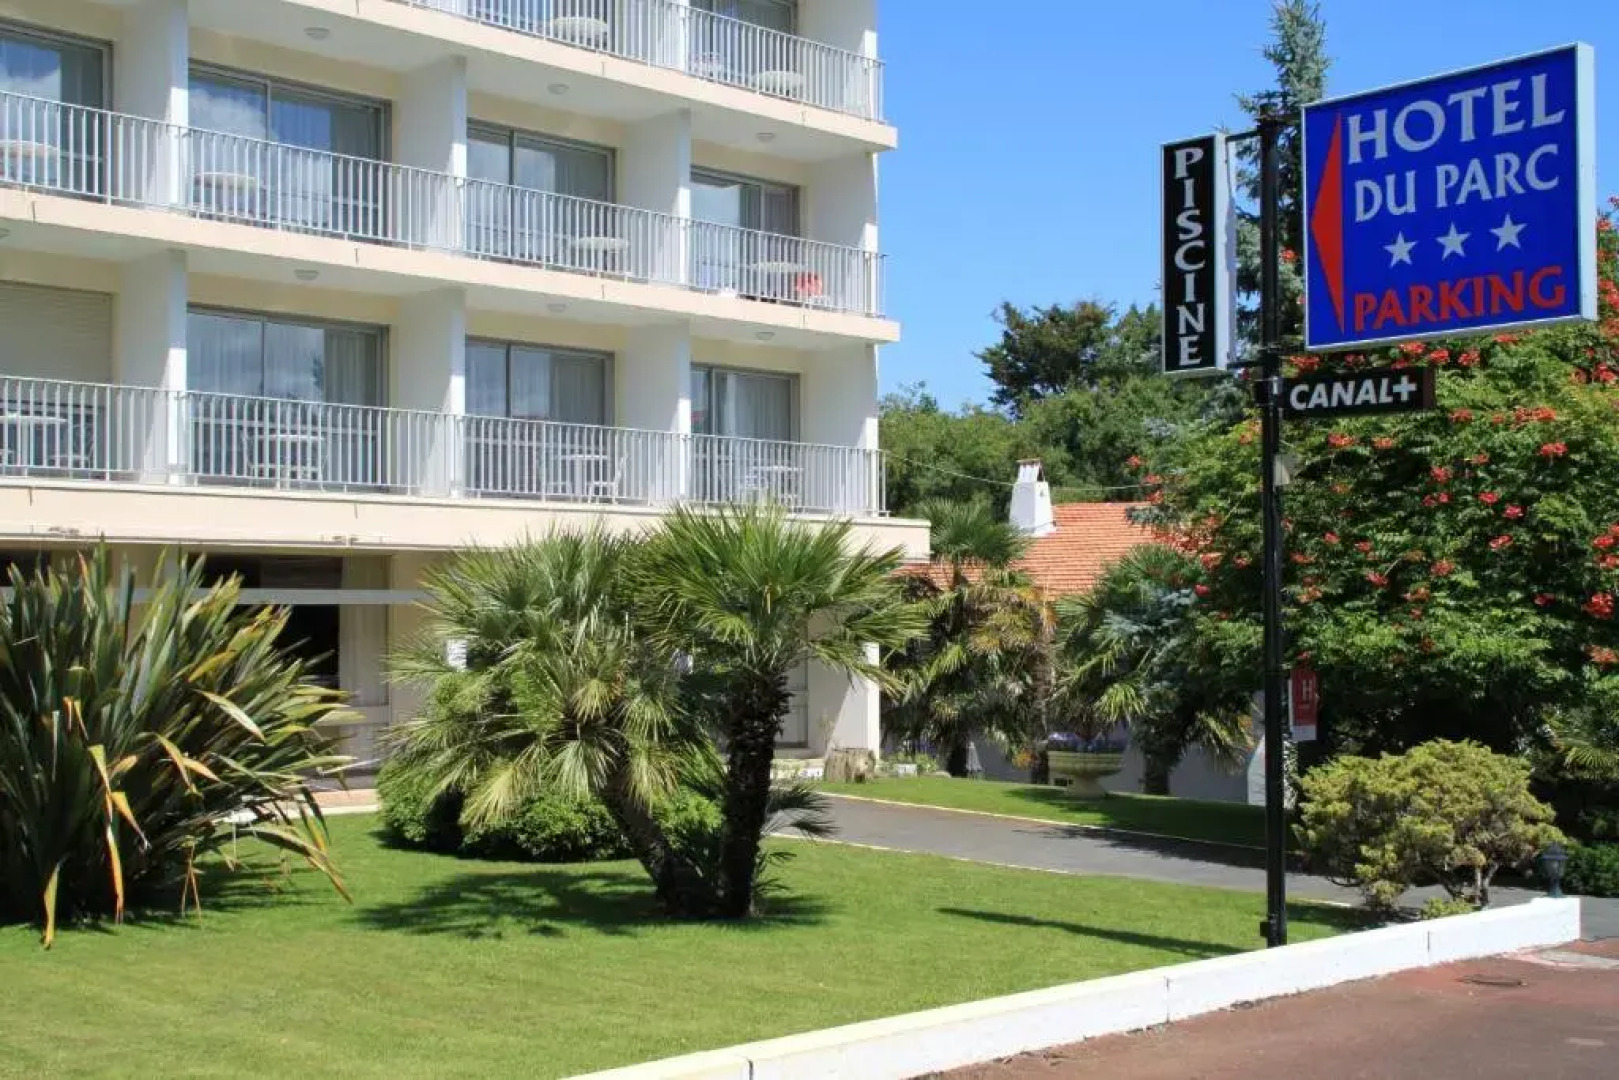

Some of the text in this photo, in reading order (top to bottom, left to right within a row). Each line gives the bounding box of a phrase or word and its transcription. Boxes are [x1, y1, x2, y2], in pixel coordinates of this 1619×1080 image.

[1347, 73, 1566, 164] HOTEL
[1354, 144, 1559, 222] DU PARC
[1174, 147, 1205, 366] PISCINE
[1354, 266, 1566, 332] PARKING
[1289, 375, 1417, 410] CANAL+
